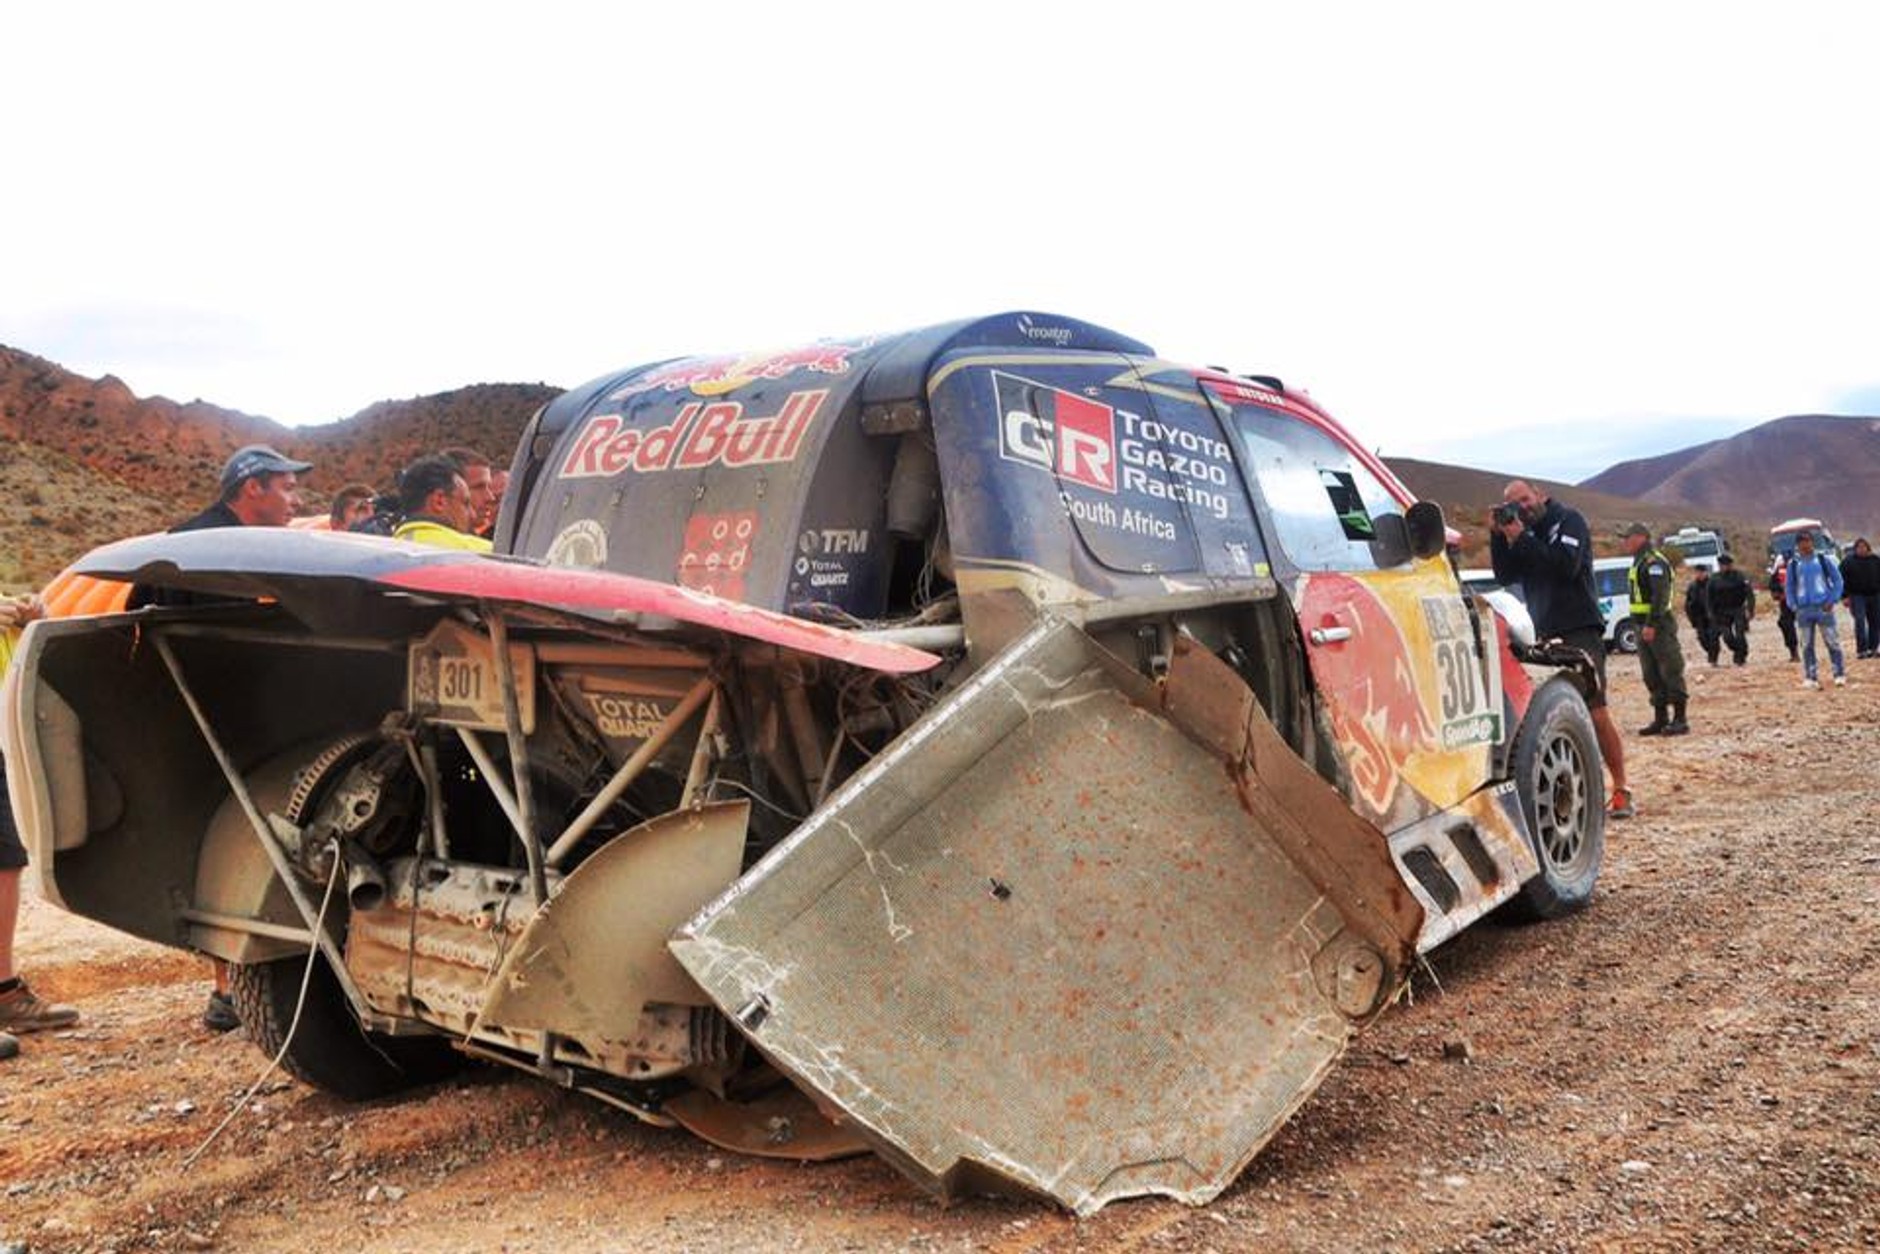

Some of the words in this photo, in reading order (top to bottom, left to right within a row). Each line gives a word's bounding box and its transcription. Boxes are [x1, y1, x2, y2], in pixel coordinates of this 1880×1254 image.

[559, 403, 696, 478] Red
[674, 388, 830, 469] Bull
[1006, 410, 1111, 487] GR
[1116, 409, 1233, 463] TOYOTA
[1120, 439, 1227, 486] GAZOO
[1059, 491, 1117, 526] South
[1122, 508, 1176, 541] Africa
[1123, 468, 1229, 520] Racing
[821, 529, 868, 553] TFM
[811, 560, 844, 572] TOTAL
[444, 661, 482, 700] 301
[582, 693, 667, 721] TOTAL
[597, 715, 665, 738] QUART
